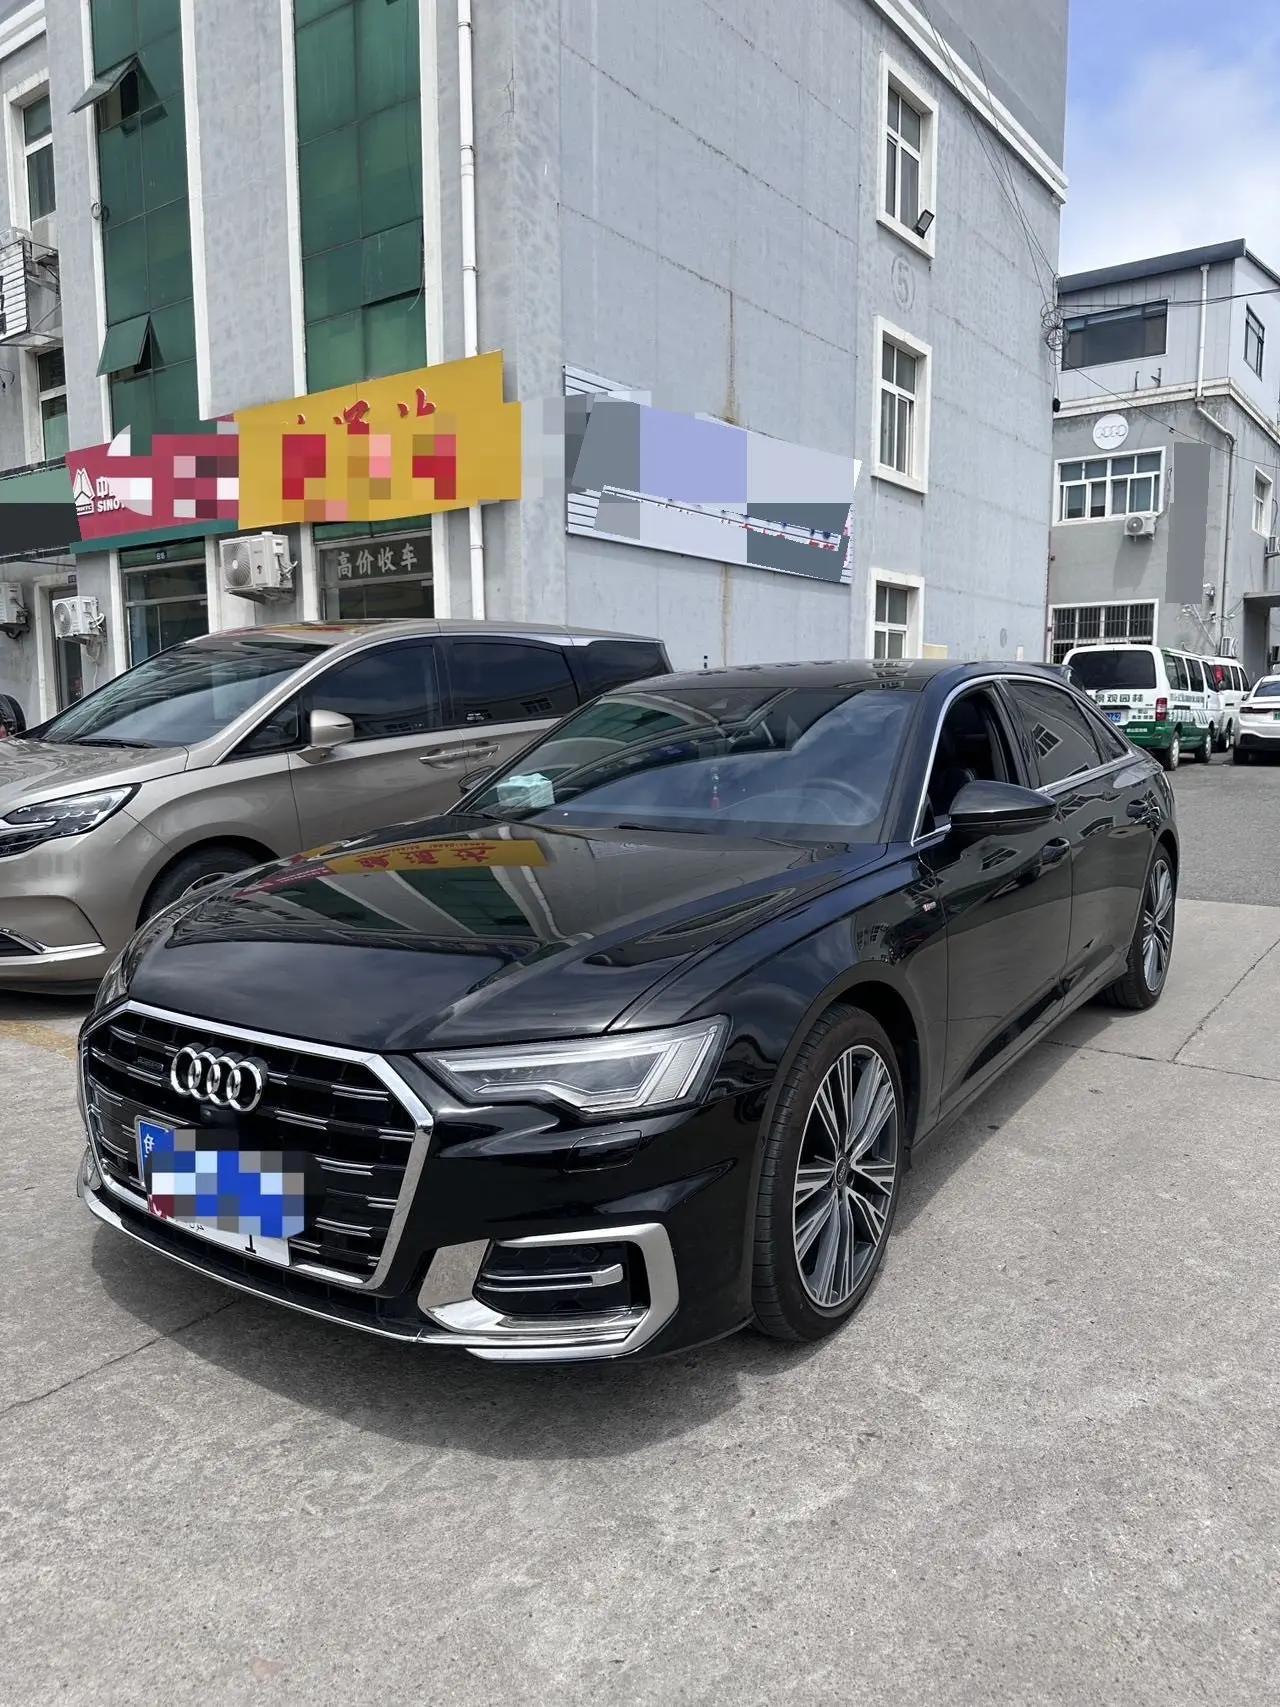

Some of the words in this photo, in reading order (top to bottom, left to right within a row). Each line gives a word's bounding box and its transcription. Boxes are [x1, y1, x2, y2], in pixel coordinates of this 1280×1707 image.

[97, 498, 124, 512] SINO
[337, 542, 418, 578] 高价收车
